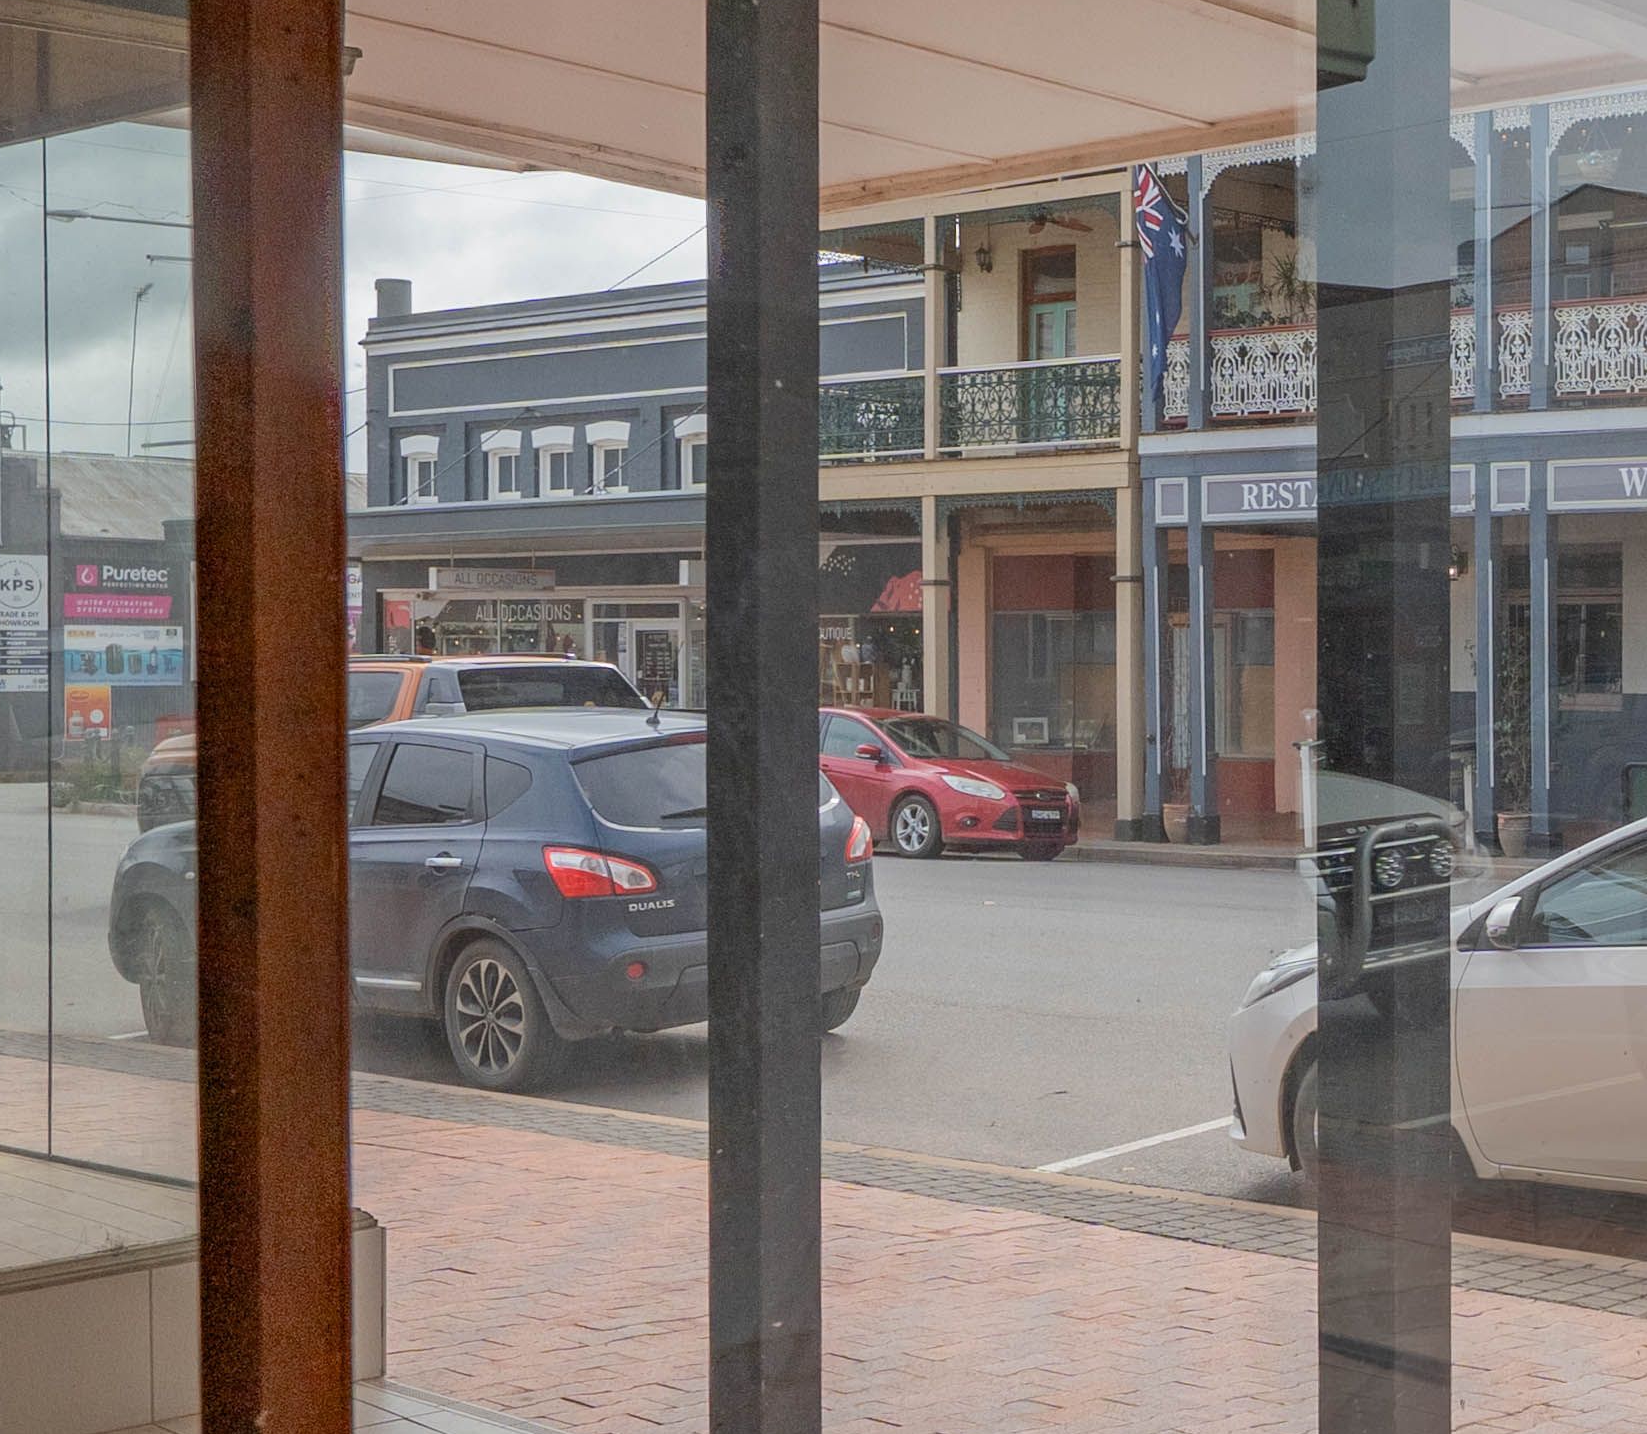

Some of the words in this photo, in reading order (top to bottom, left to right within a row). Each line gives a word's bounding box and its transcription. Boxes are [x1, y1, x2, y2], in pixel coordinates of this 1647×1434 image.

[102, 565, 169, 583] Puretec
[455, 571, 476, 585] ALL
[477, 570, 538, 586] OCCASIONS
[0, 578, 35, 592] KPS
[475, 603, 497, 622] ALL
[501, 603, 573, 622] OCCASIONS
[628, 899, 676, 913] DUALIS
